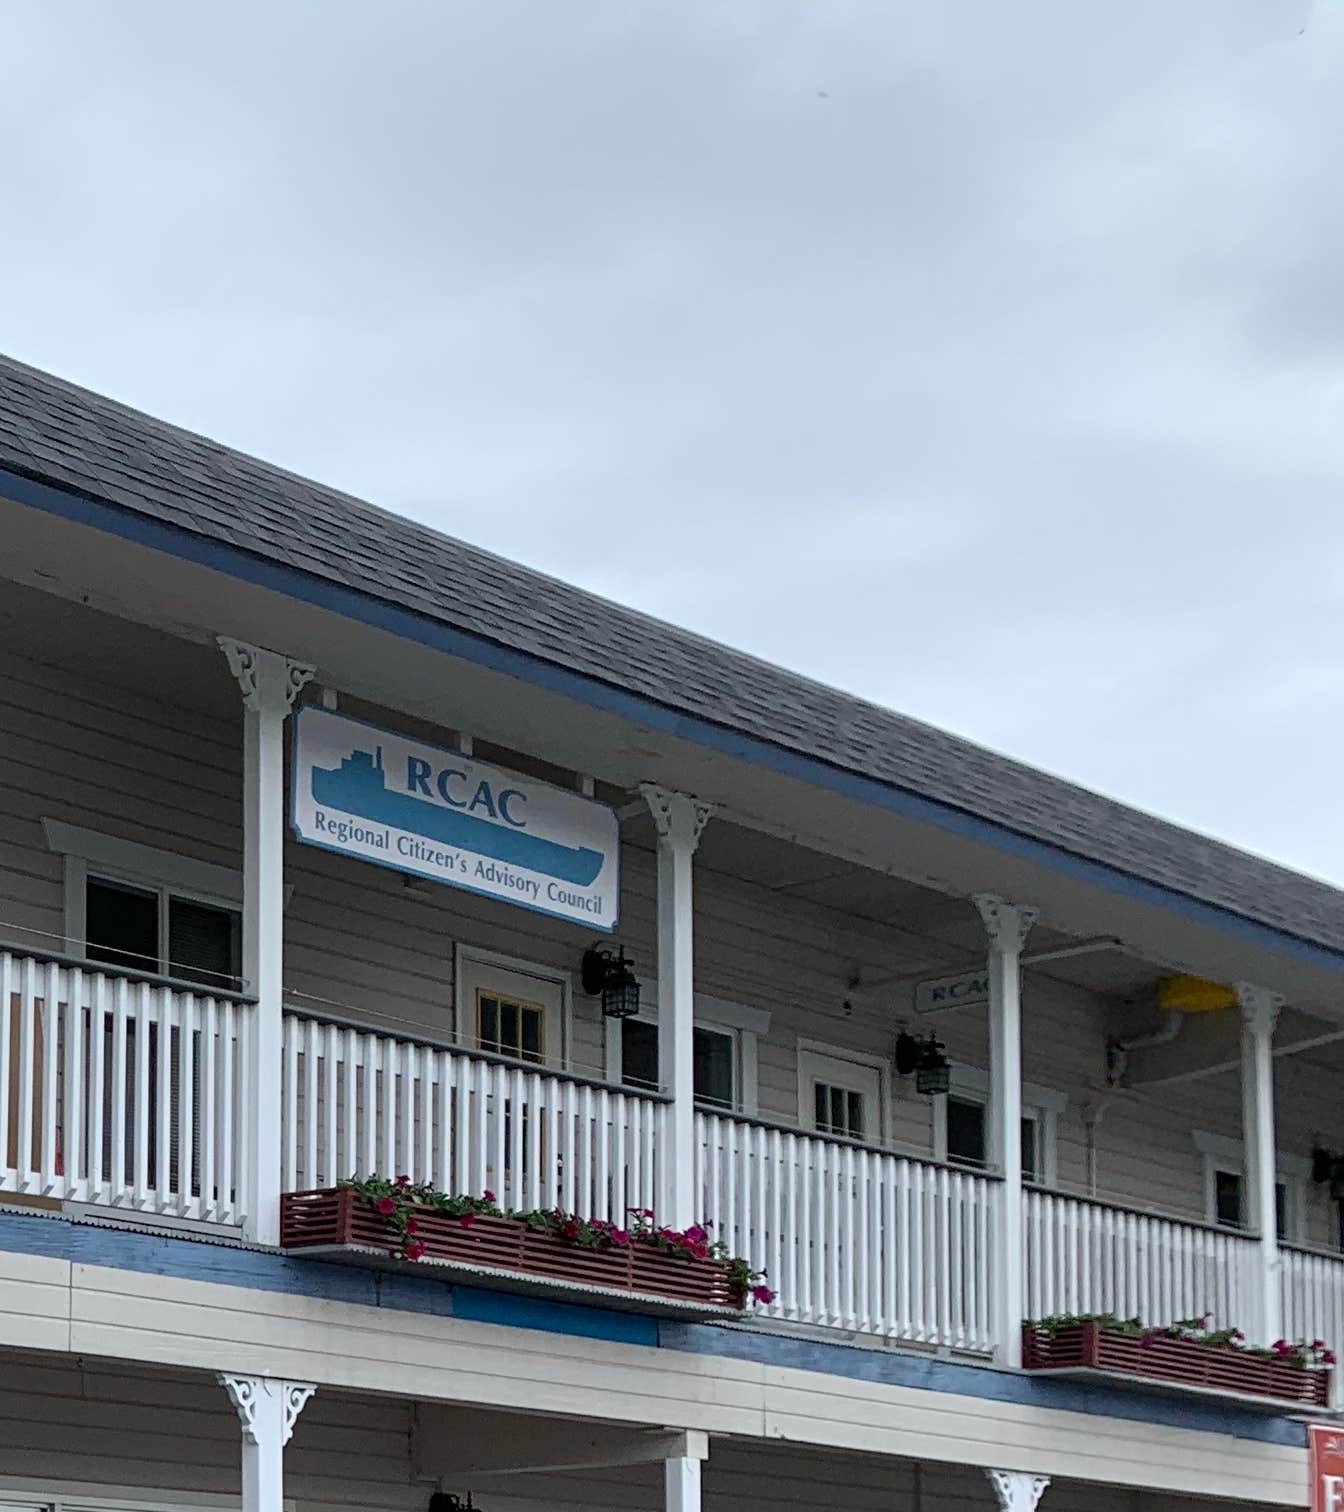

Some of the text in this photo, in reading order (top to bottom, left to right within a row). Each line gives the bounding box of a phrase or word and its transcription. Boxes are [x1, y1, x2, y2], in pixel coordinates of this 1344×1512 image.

[407, 755, 527, 827] RCAC
[315, 811, 603, 914] Regional Citizen's Advisory Council
